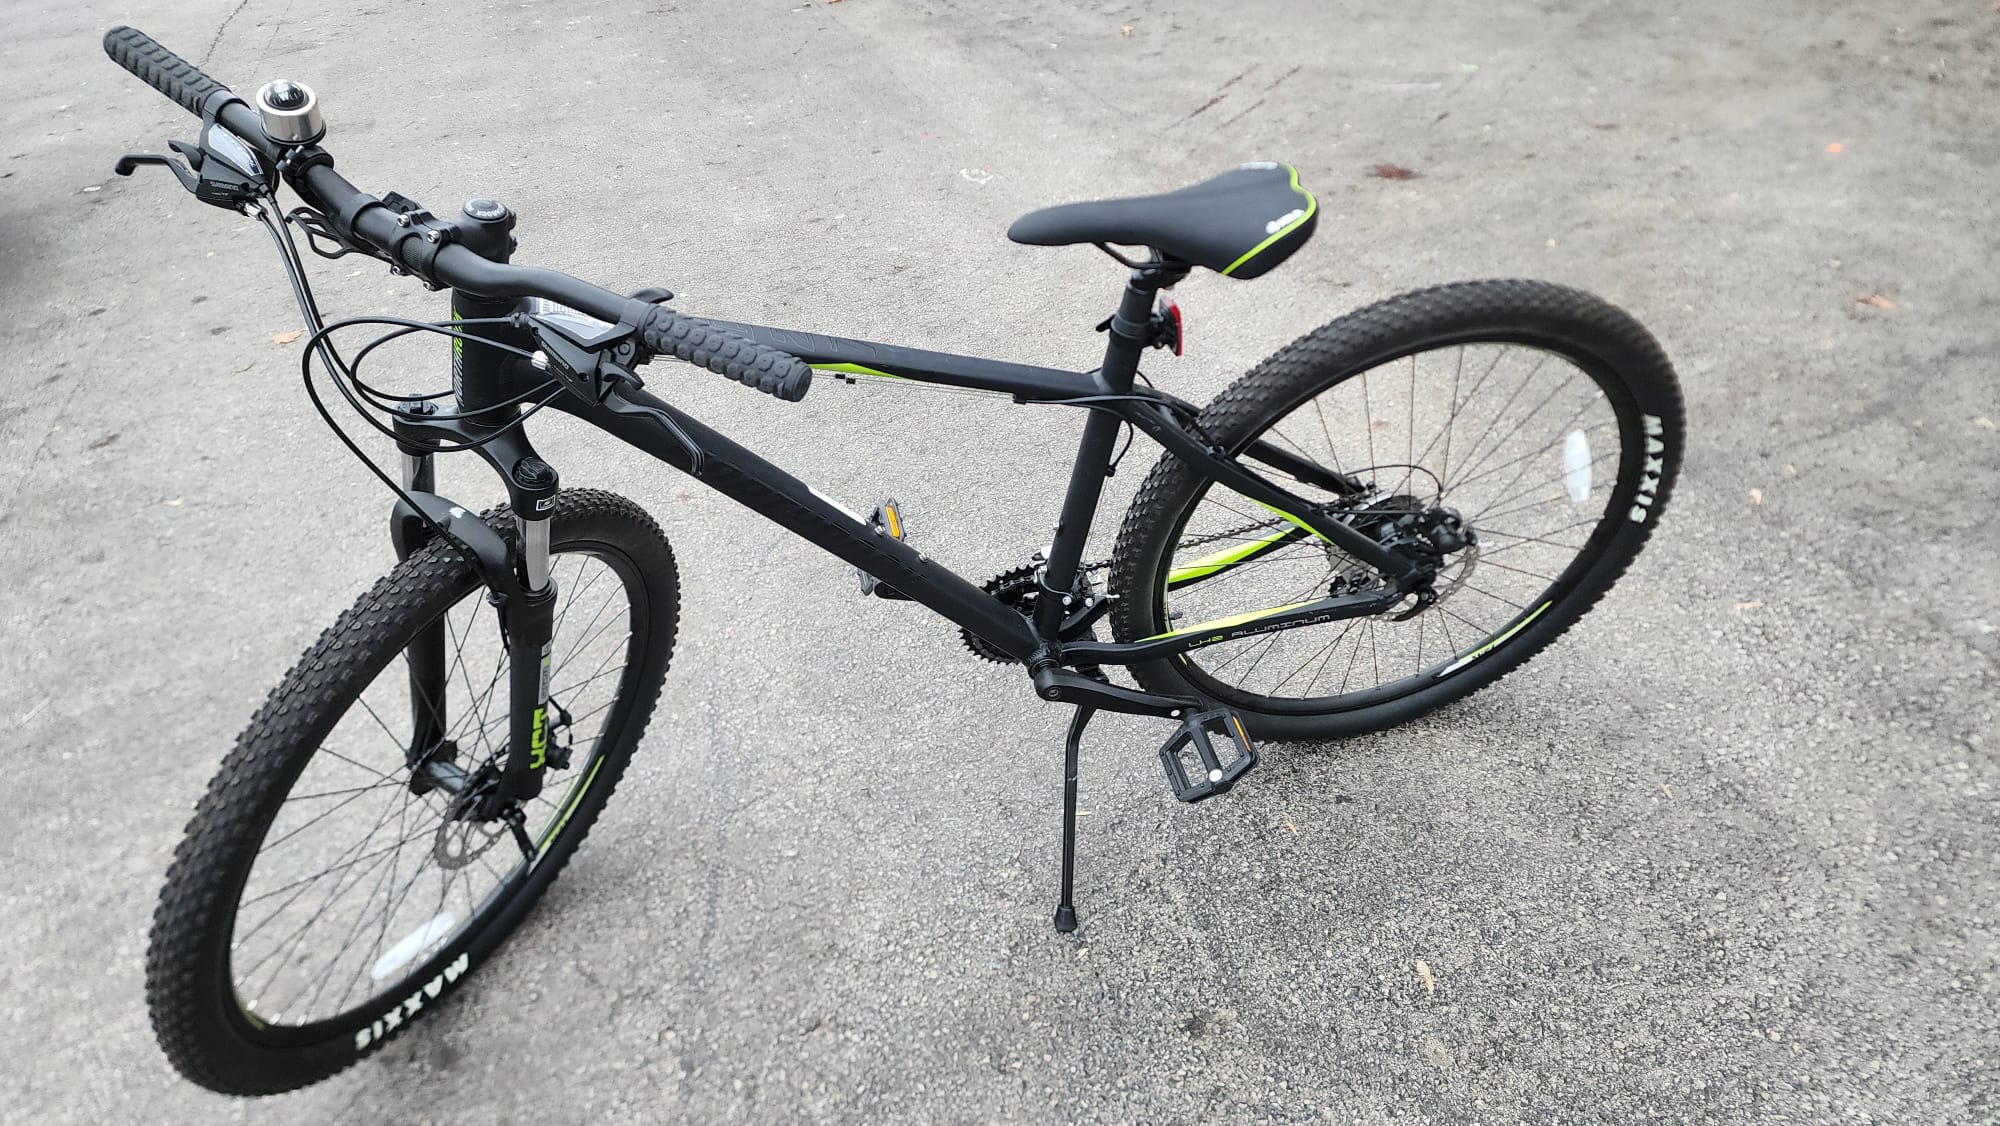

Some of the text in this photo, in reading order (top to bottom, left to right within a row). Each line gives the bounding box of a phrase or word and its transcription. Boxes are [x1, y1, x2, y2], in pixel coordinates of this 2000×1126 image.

[1629, 413, 1664, 523] MAXXIS
[1231, 614, 1331, 638] ALUMINUM
[355, 952, 469, 1051] MAXXIS
